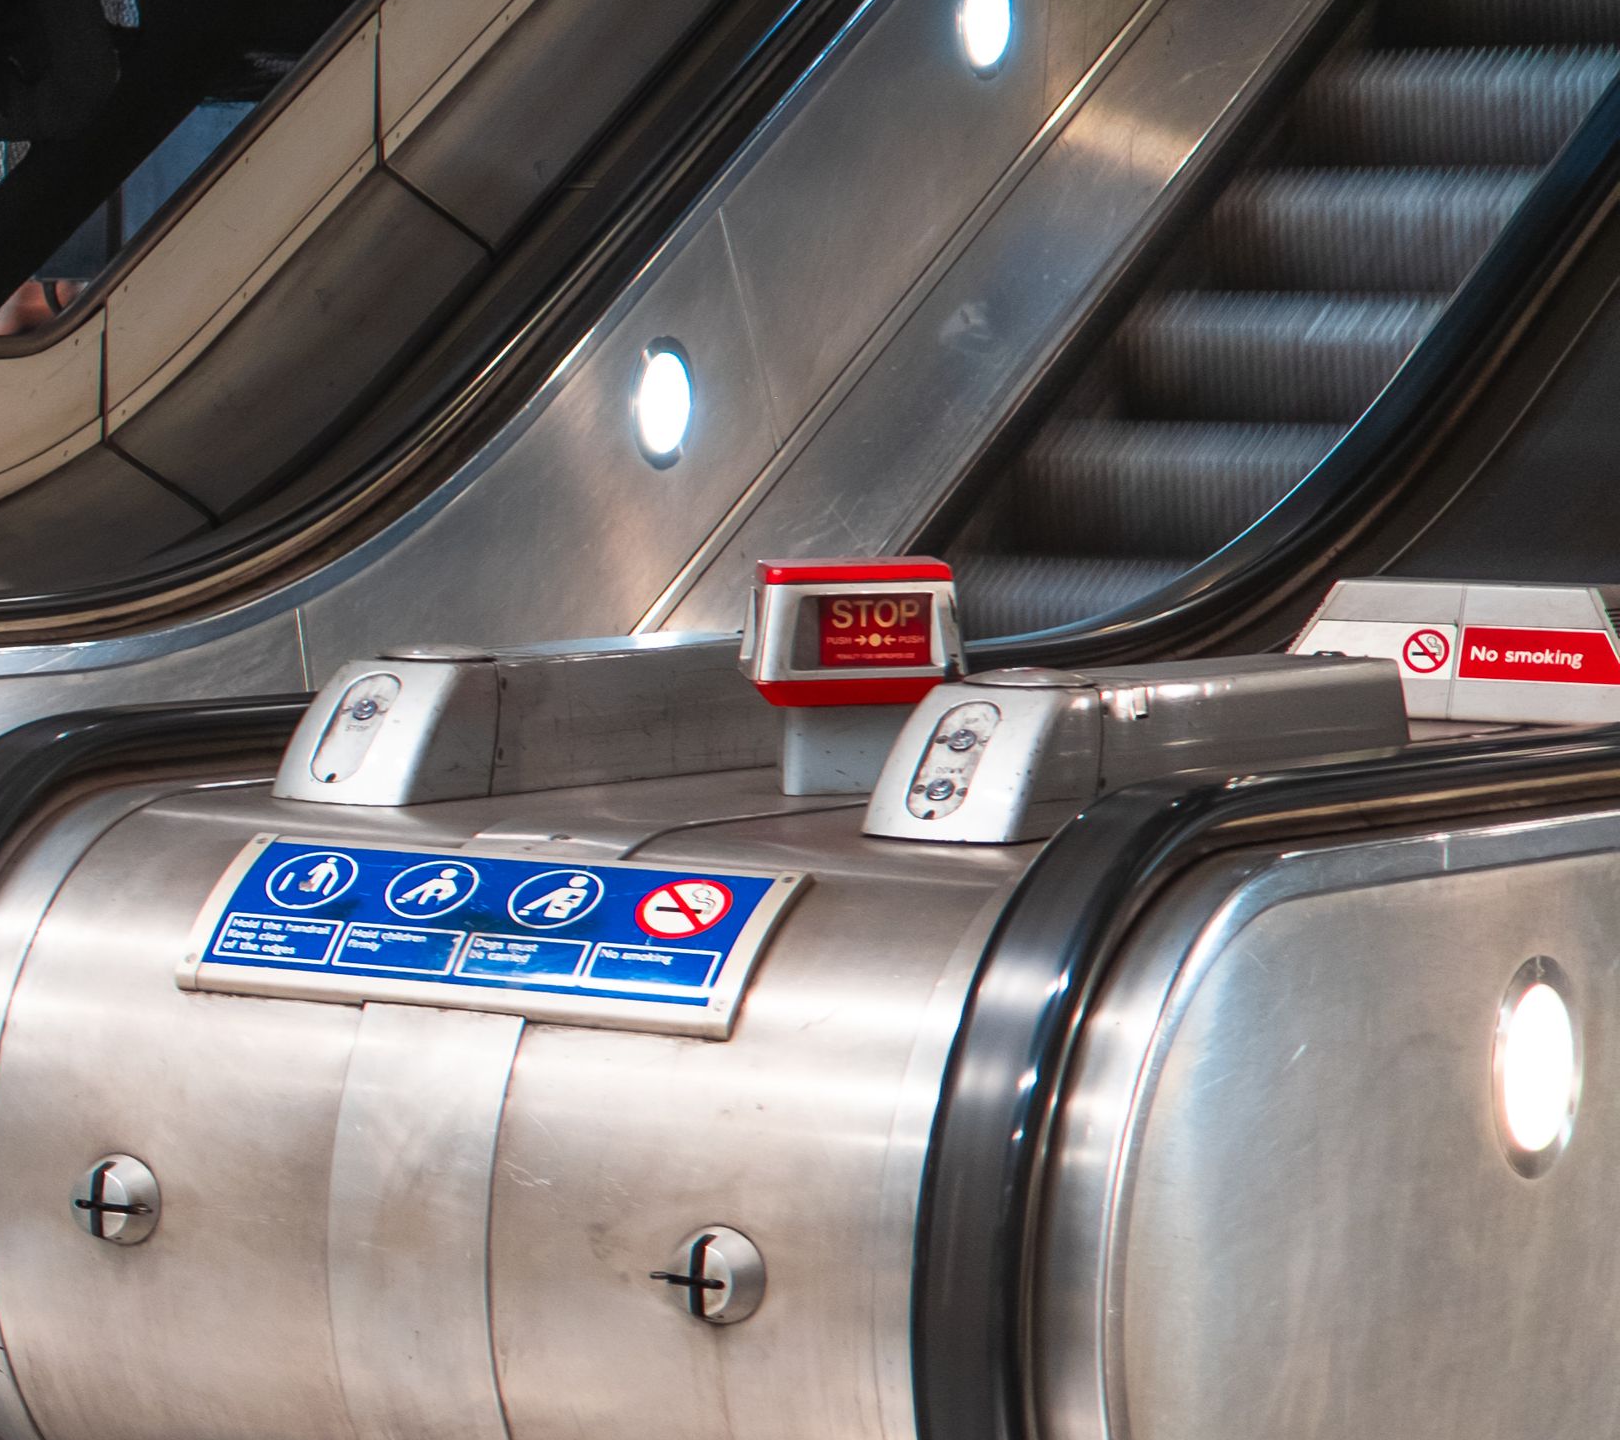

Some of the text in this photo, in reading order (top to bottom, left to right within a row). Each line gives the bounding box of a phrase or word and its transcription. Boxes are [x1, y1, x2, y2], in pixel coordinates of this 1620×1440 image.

[831, 599, 920, 629] STOP
[826, 635, 925, 645] PUSH PUSH
[1470, 646, 1584, 669] No smoking
[232, 918, 331, 935] Hold the handrail
[227, 929, 288, 942] Keep clear
[351, 928, 428, 943] Hold children
[222, 939, 296, 956] of the edges
[473, 937, 539, 953] Dogs must
[468, 949, 531, 964] be carried
[599, 948, 674, 966] No smoking
